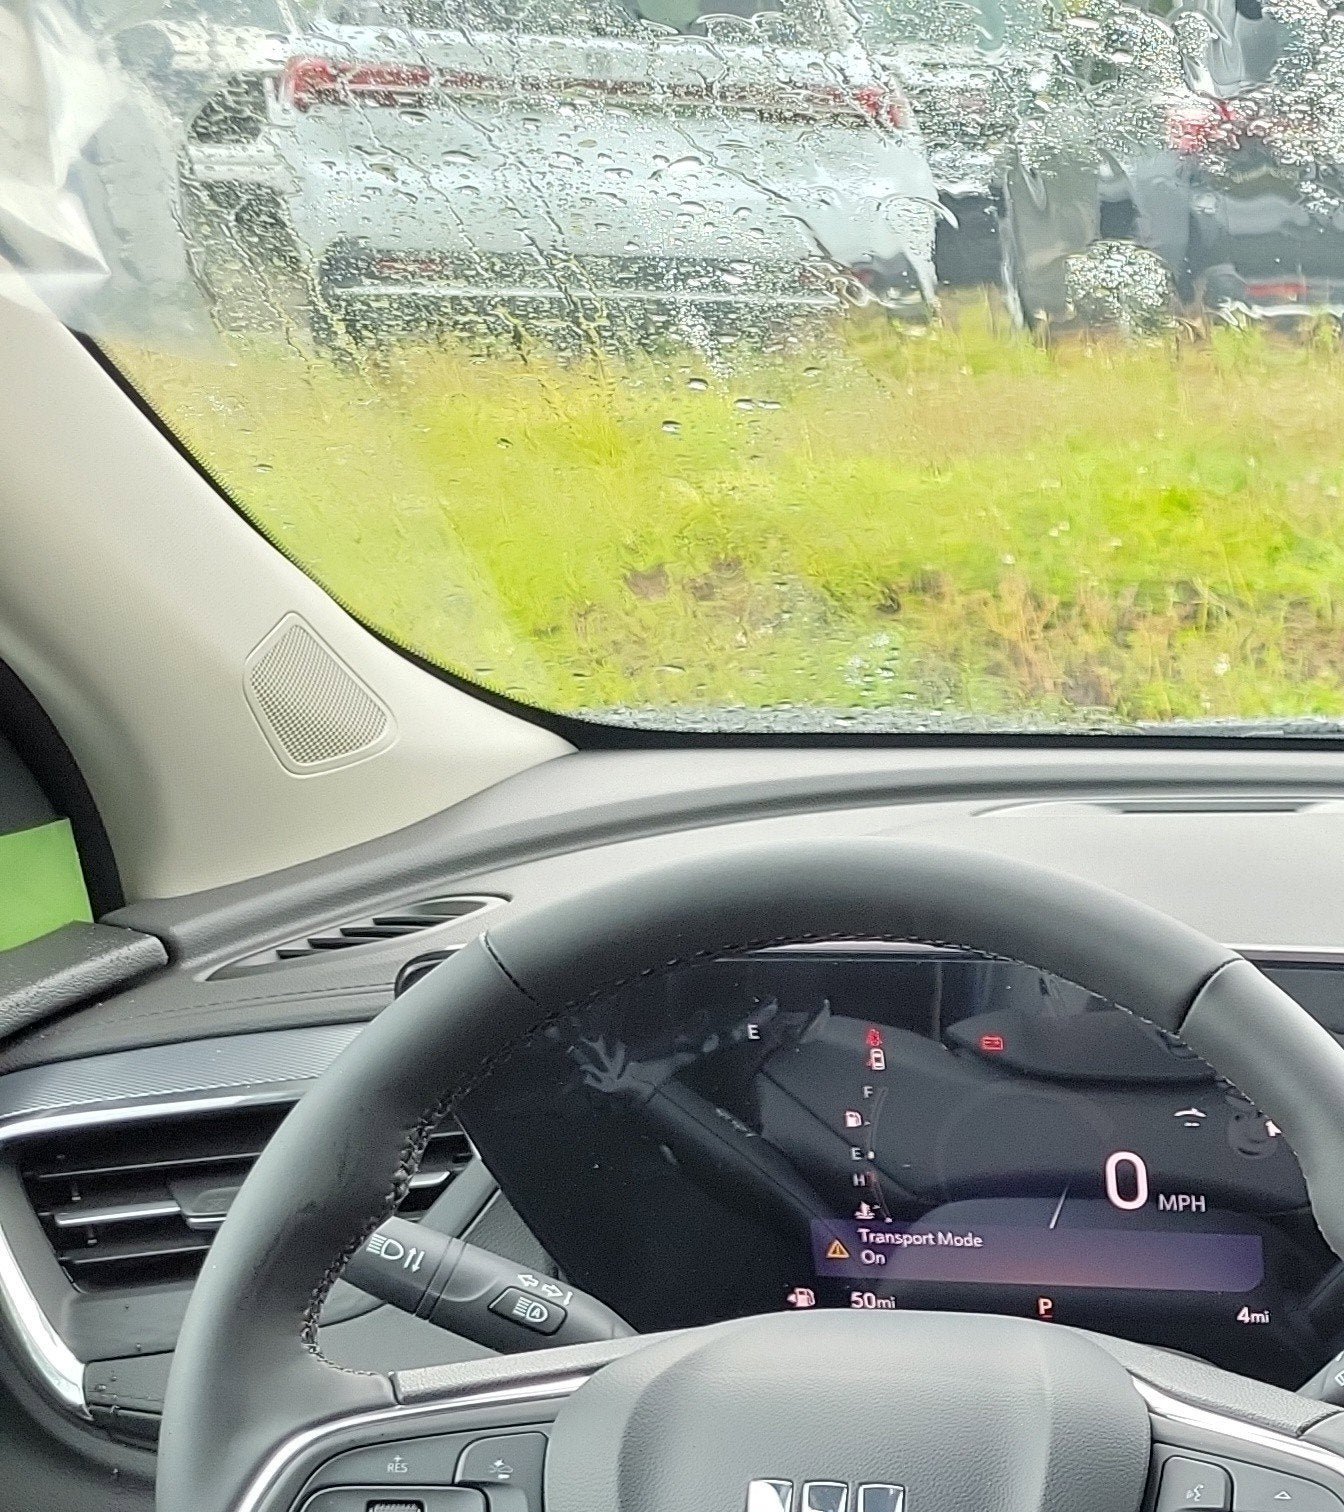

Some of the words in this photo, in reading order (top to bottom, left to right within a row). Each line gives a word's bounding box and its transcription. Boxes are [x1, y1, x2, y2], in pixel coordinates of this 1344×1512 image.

[747, 1024, 760, 1040] E
[863, 1086, 873, 1098] F
[851, 1147, 862, 1160] E
[853, 1173, 866, 1187] H
[1104, 1151, 1149, 1210] 0
[1158, 1193, 1206, 1212] MPH
[857, 1228, 935, 1247] Transport
[938, 1232, 984, 1248] Mode
[861, 1250, 886, 1265] On
[1038, 1298, 1053, 1316] P
[387, 1462, 408, 1473] RES
